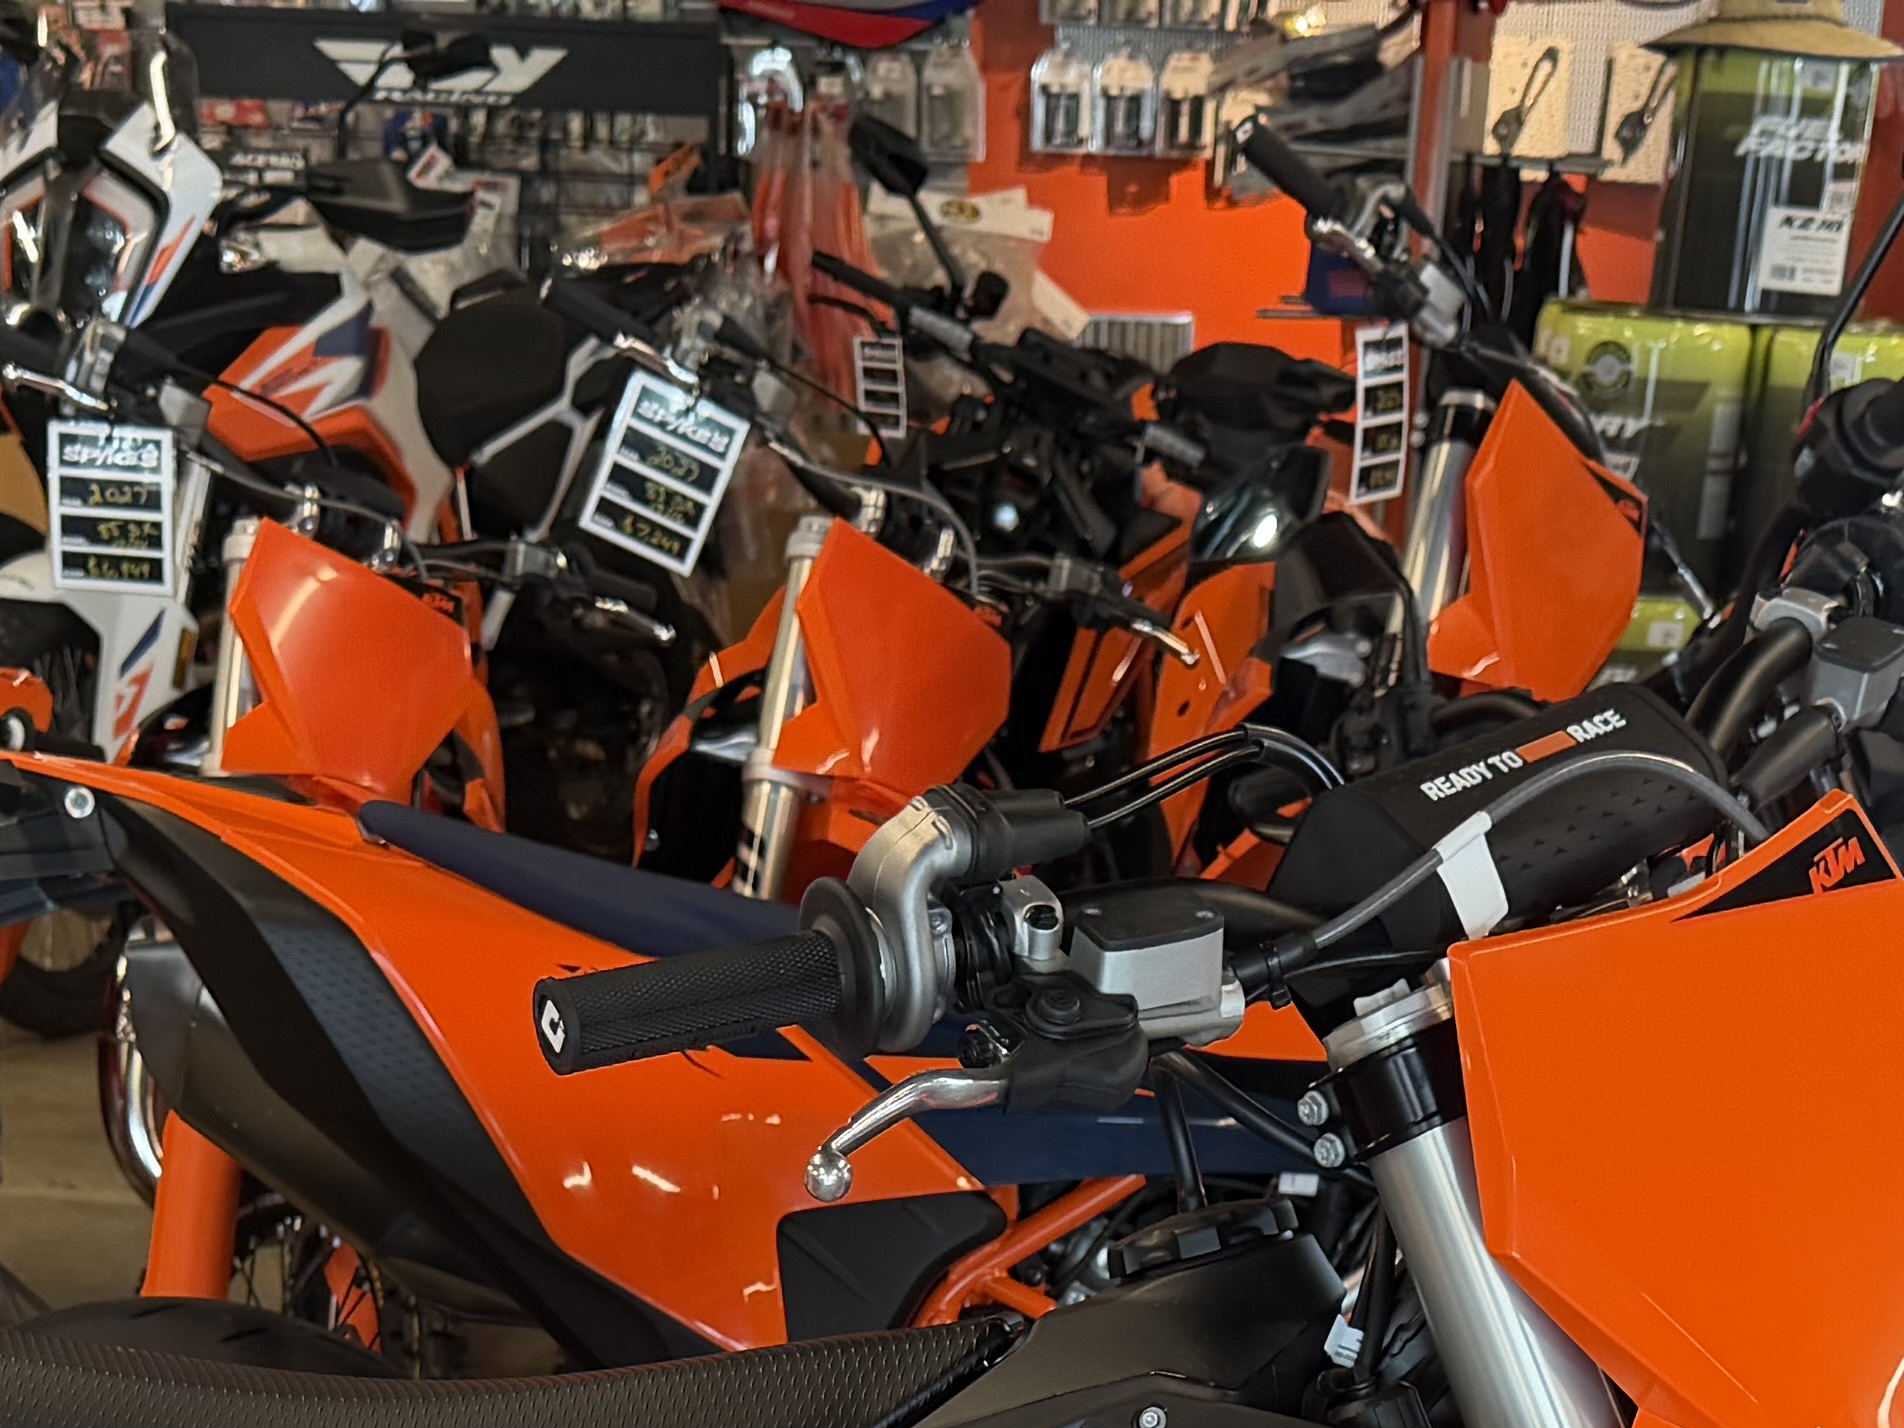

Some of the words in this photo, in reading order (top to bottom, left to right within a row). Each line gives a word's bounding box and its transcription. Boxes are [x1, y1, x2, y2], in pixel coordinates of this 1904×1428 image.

[1420, 758, 1493, 801] READY
[1487, 749, 1525, 774] TO
[1566, 708, 1628, 744] RACE
[1808, 835, 1865, 894] KTM
